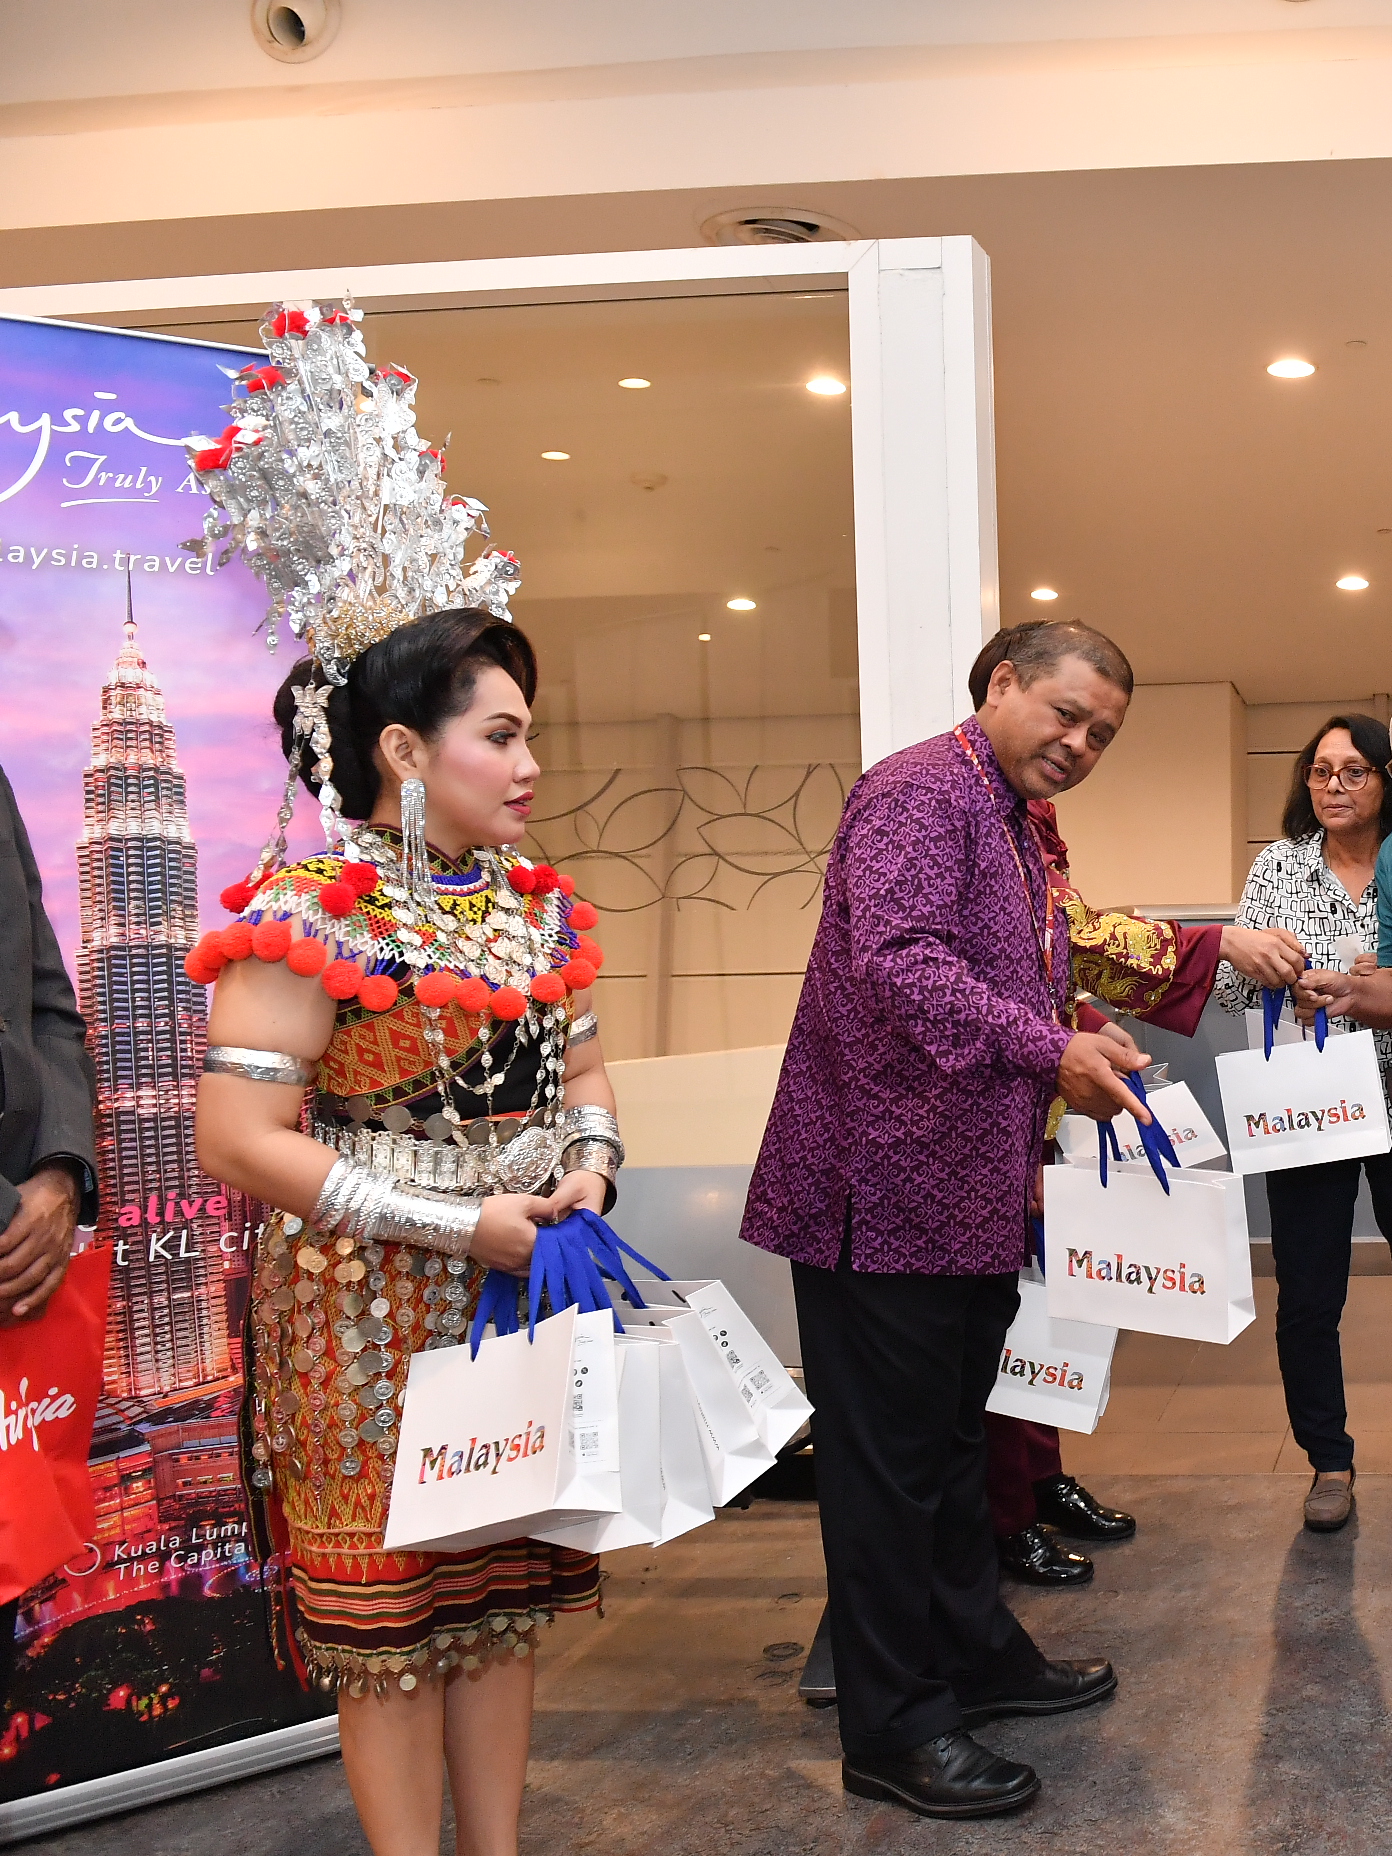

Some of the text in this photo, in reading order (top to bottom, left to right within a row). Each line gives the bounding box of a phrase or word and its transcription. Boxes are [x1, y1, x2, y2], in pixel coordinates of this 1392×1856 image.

[0, 391, 184, 500] ysia
[62, 451, 162, 496] Truly
[1243, 1100, 1366, 1138] Malaysia
[118, 1191, 228, 1227] alive
[150, 1229, 201, 1262] KL
[1065, 1247, 1207, 1297] Malaysia
[418, 1420, 546, 1485] Malaysia
[113, 1534, 180, 1562] Kuala
[113, 1560, 159, 1581] The
